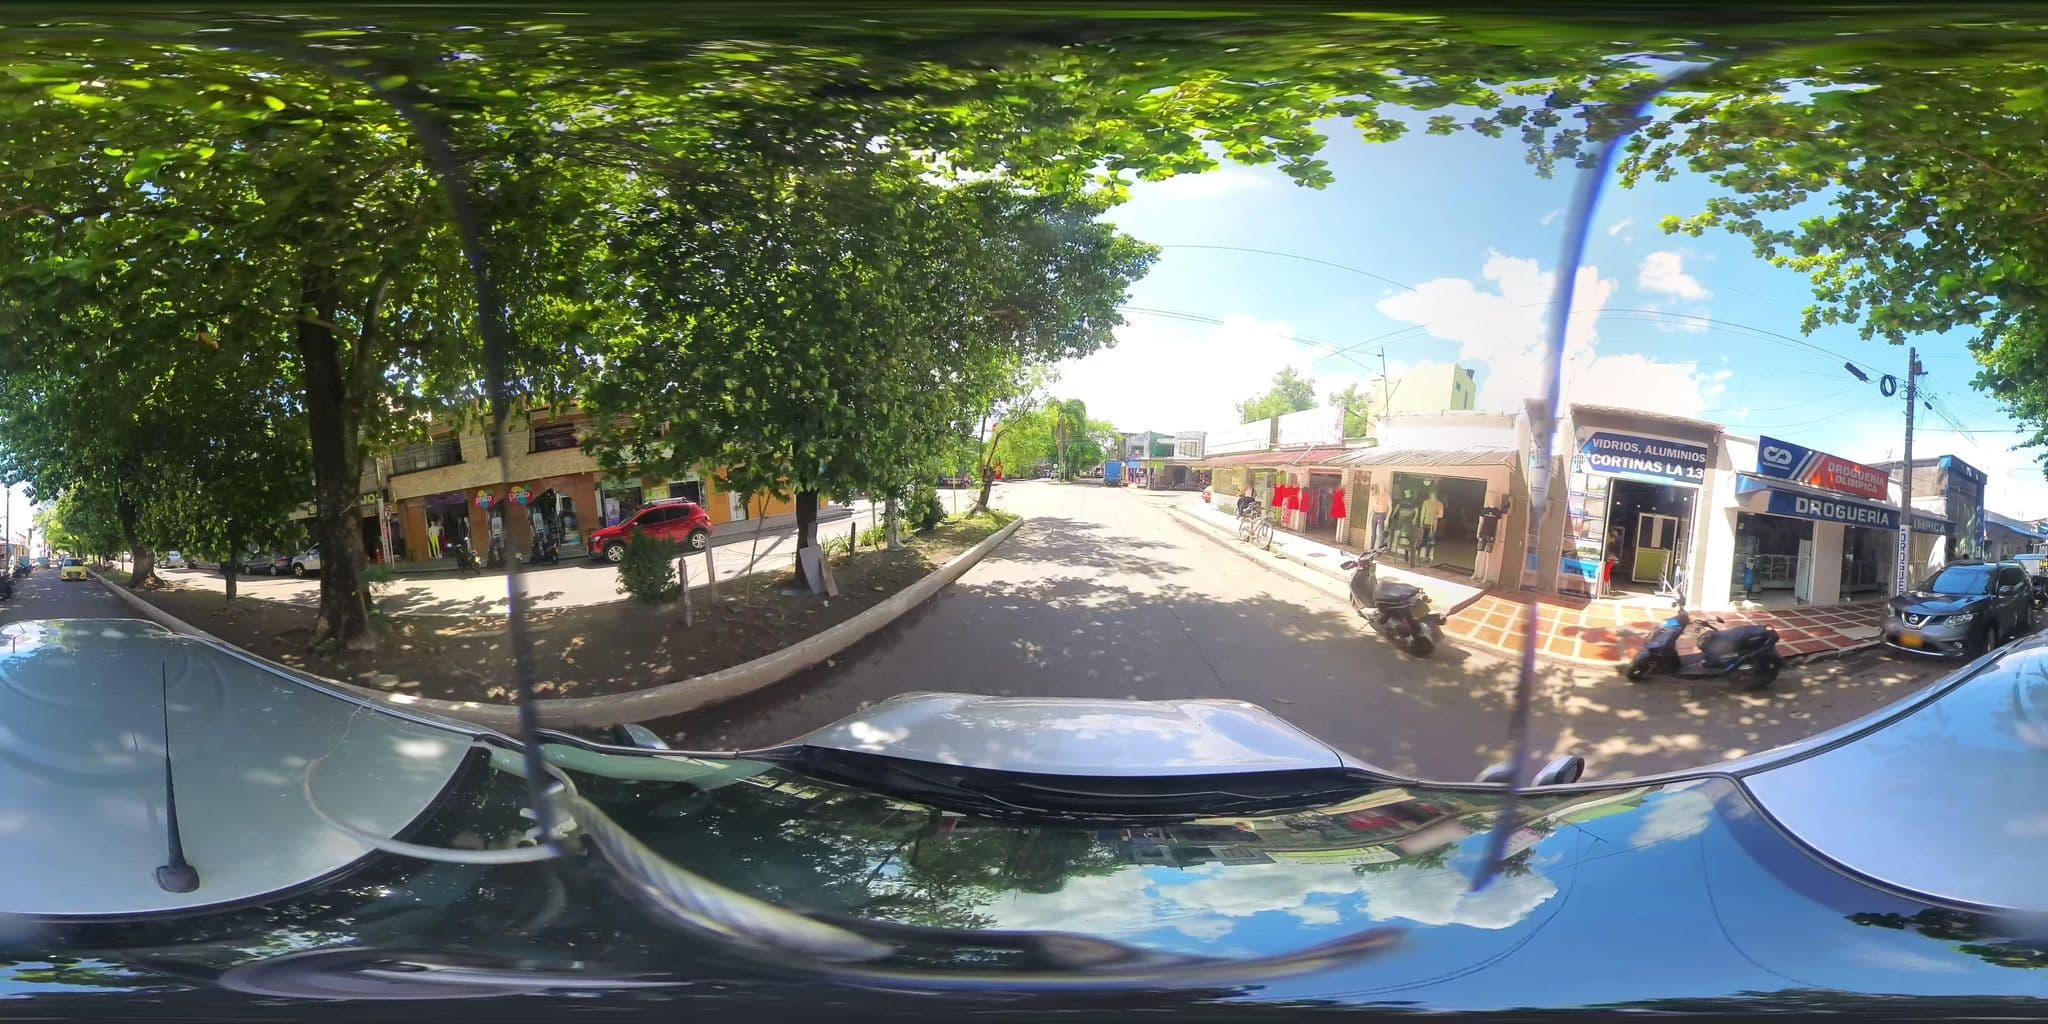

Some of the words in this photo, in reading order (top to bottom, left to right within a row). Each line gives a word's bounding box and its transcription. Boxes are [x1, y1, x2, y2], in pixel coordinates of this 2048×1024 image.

[1592, 438, 1642, 455] VIDRIOS,
[1644, 445, 1706, 463] ALUMINIOS
[1591, 453, 1662, 473] CORTINAS
[1665, 463, 1683, 476] LA
[1685, 467, 1704, 480] 13
